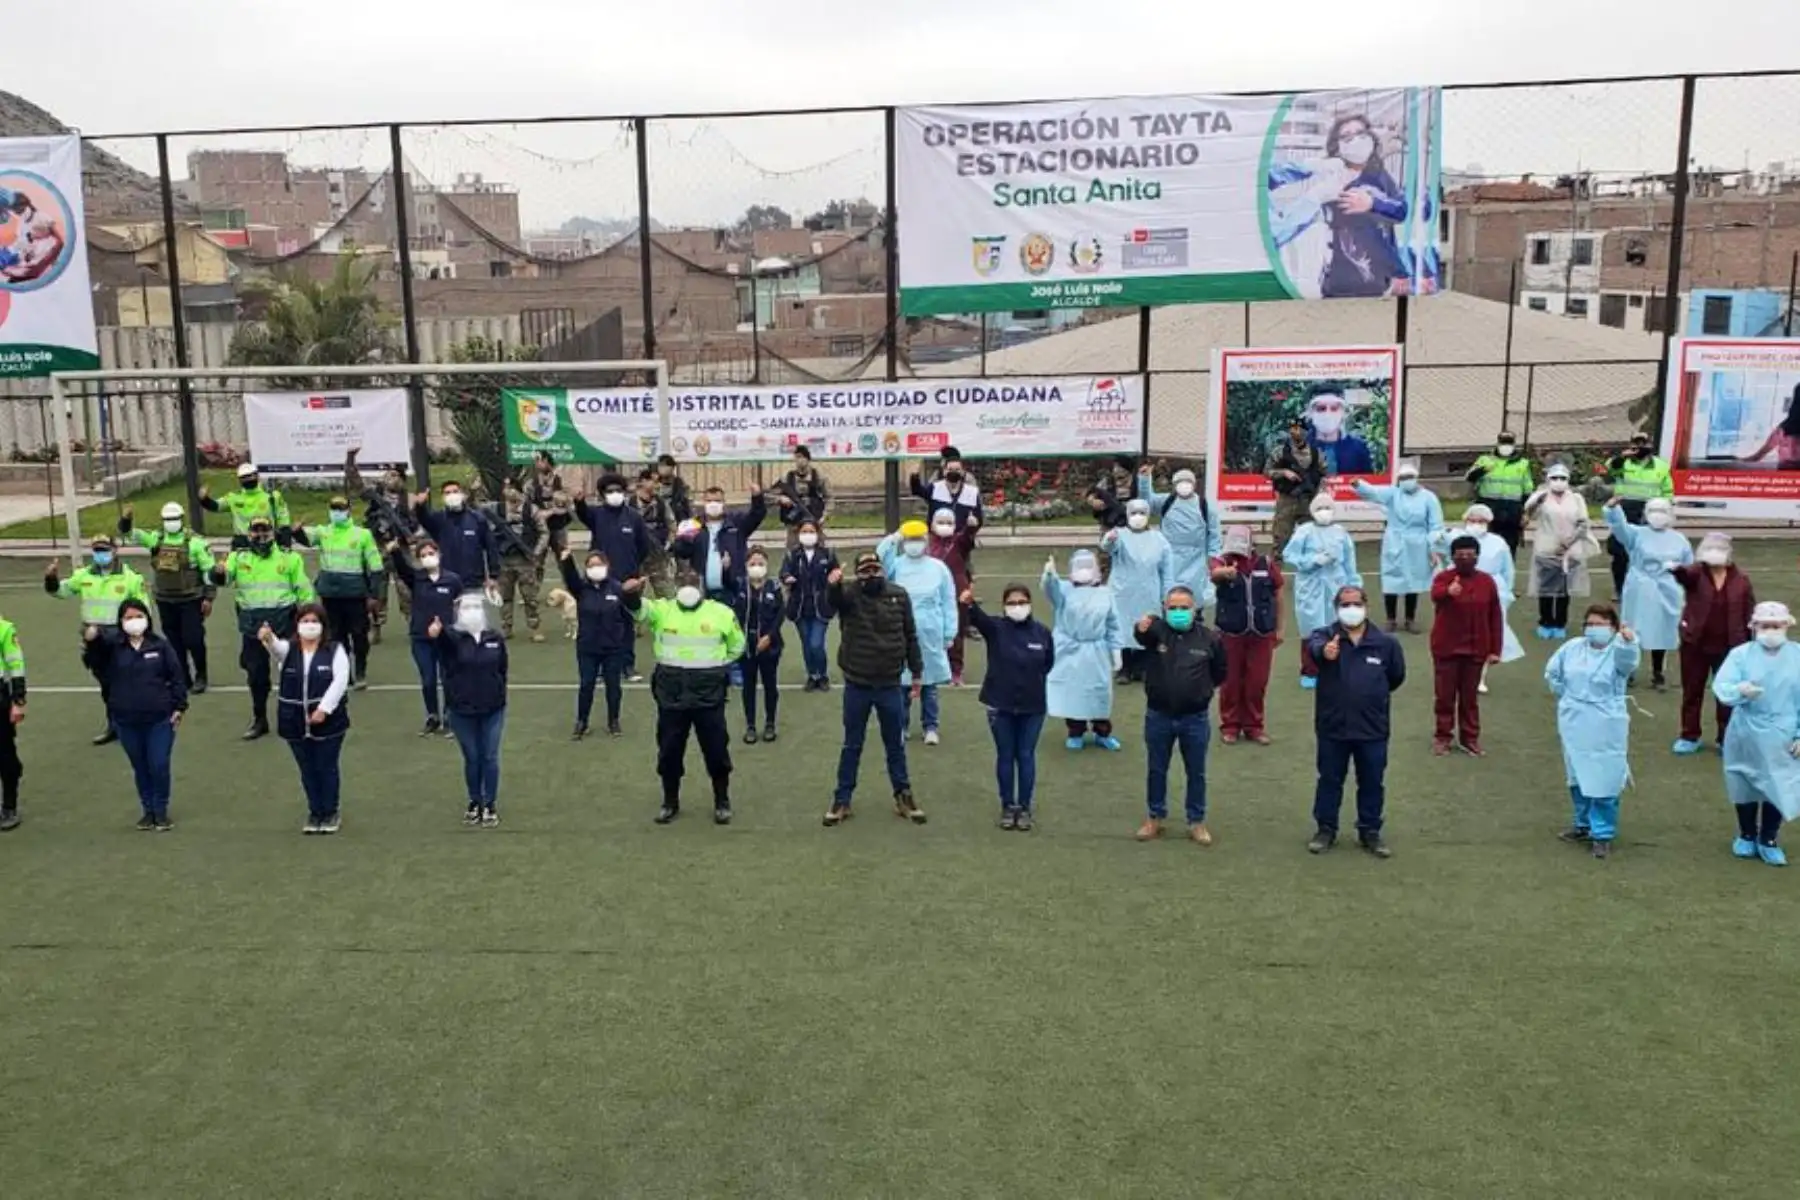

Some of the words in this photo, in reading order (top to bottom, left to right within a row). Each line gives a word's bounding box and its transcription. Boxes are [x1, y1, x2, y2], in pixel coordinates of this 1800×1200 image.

[923, 110, 1120, 147] OPERACIÓN
[1130, 110, 1233, 138] TAYTA
[956, 142, 1200, 177] ESTACIONARIO
[992, 181, 1077, 208] Santa
[1085, 177, 1162, 203] Anita
[575, 391, 655, 413] COMITÉ
[771, 393, 800, 409] DE
[807, 388, 928, 409] SEGURIDAD
[935, 386, 1063, 405] CIUDADANA
[855, 415, 880, 427] LEY
